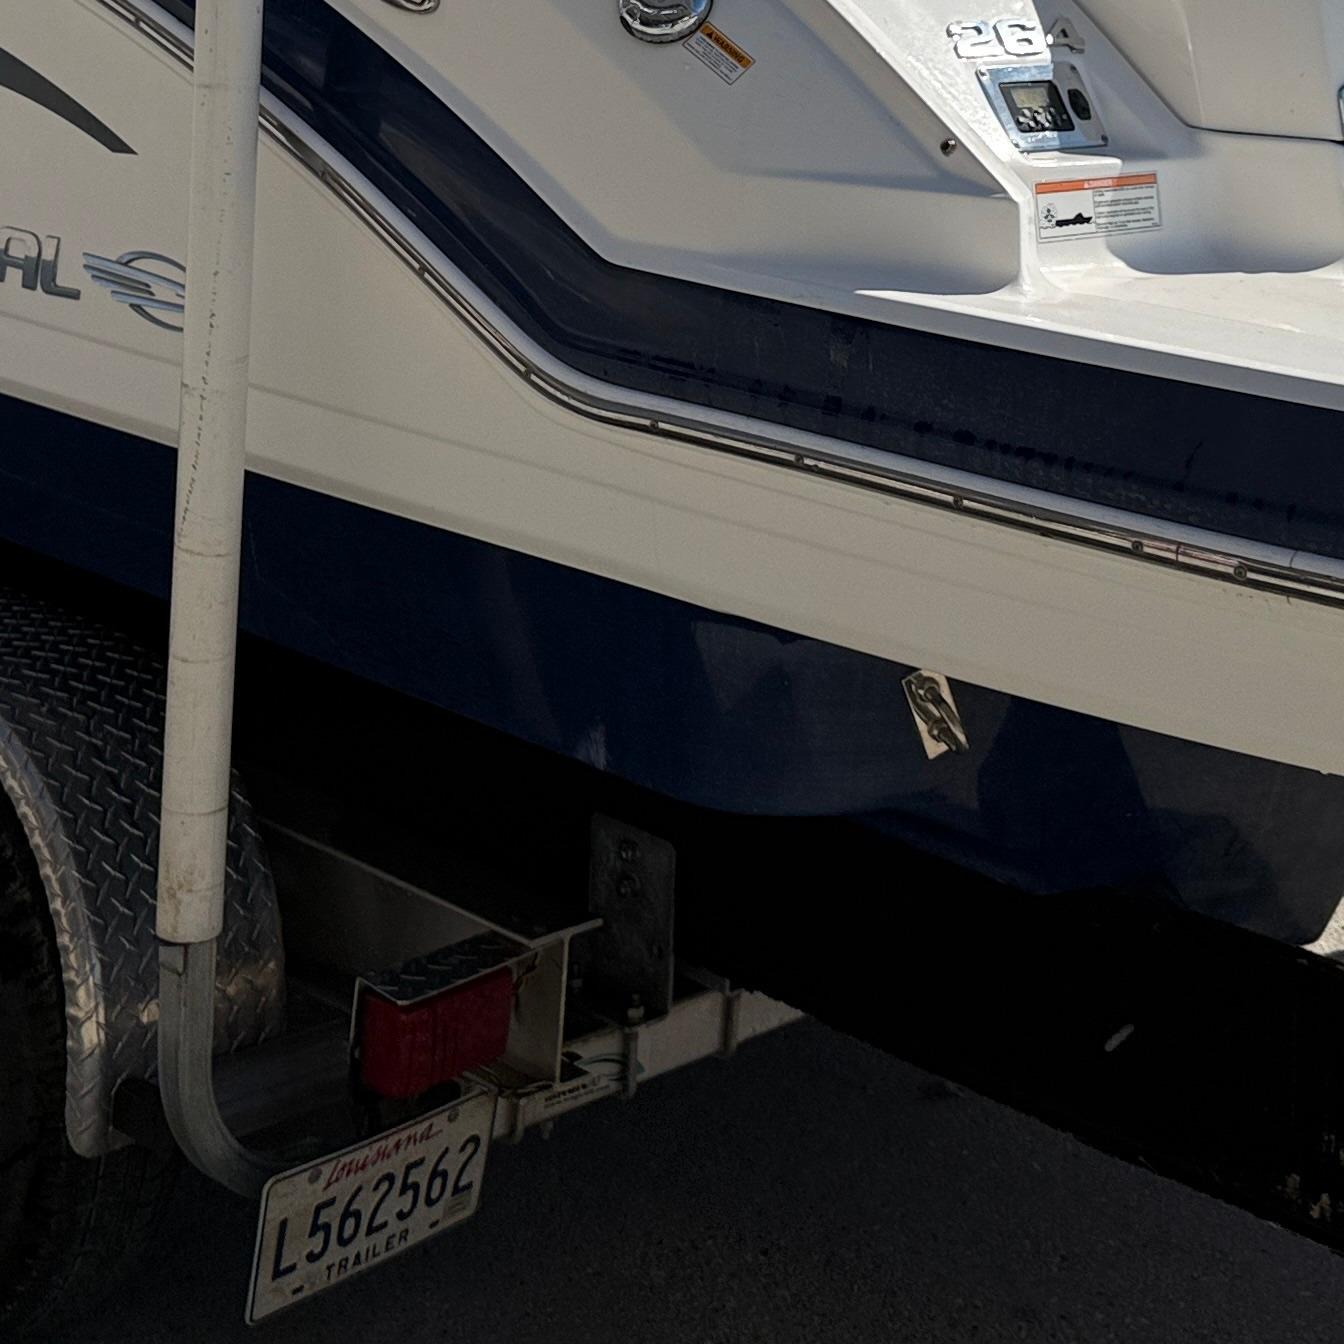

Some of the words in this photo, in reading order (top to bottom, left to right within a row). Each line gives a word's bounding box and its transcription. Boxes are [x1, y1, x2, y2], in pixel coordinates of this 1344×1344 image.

[323, 1123, 444, 1192] Louisiana
[272, 1134, 481, 1282] L562562
[326, 1229, 409, 1281] TRAILER
